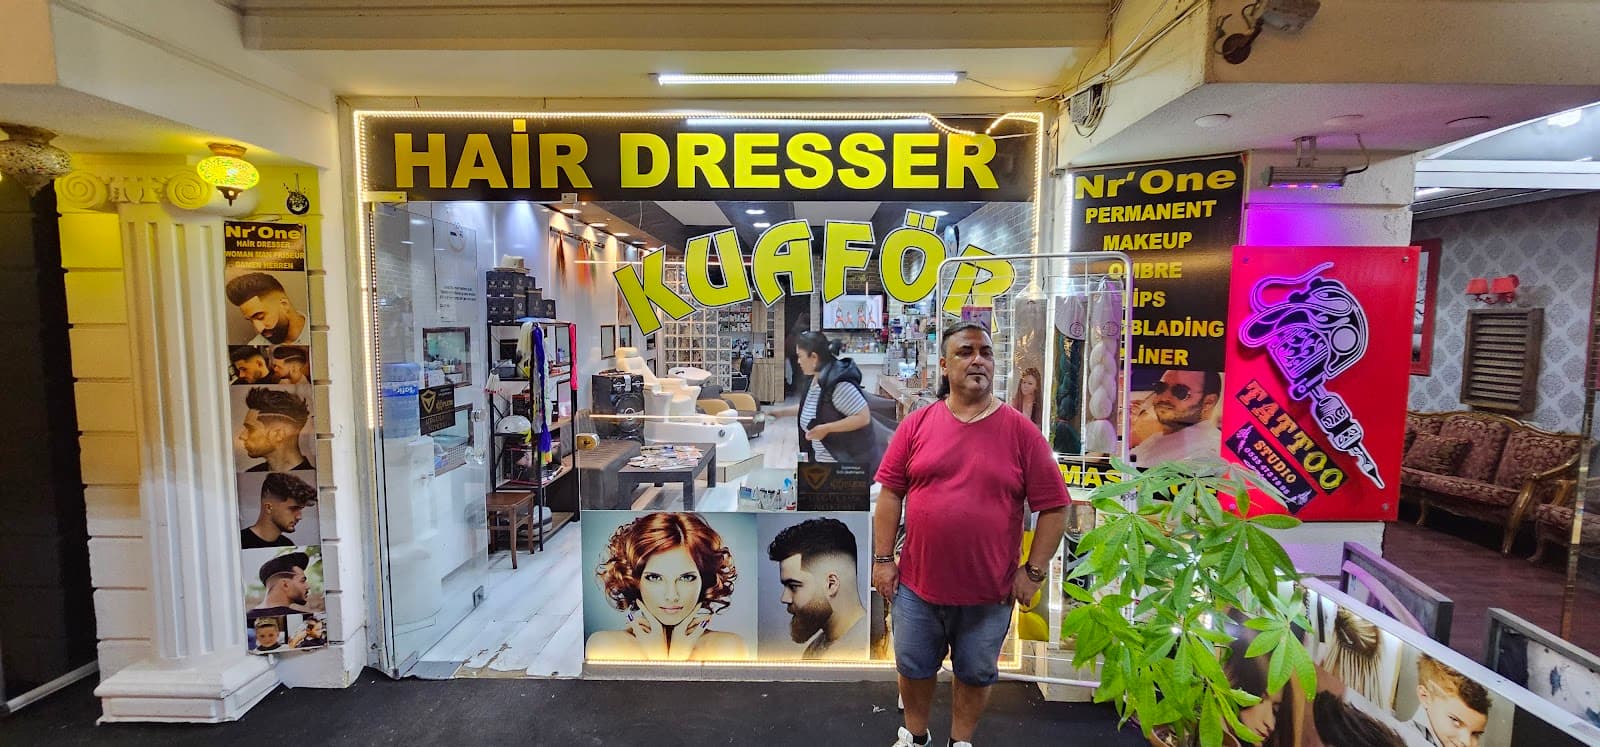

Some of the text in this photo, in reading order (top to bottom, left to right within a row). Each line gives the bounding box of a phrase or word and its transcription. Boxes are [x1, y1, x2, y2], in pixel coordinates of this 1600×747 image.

[394, 118, 999, 190] HAİR DRESSER
[1085, 200, 1217, 224] PERMANENT
[224, 250, 253, 258] WOMAN
[1103, 231, 1193, 252] MAKEUP
[612, 208, 1017, 337] KUAFÖR
[1239, 380, 1343, 490] TATTOO
[1253, 440, 1297, 484] STUDIO
